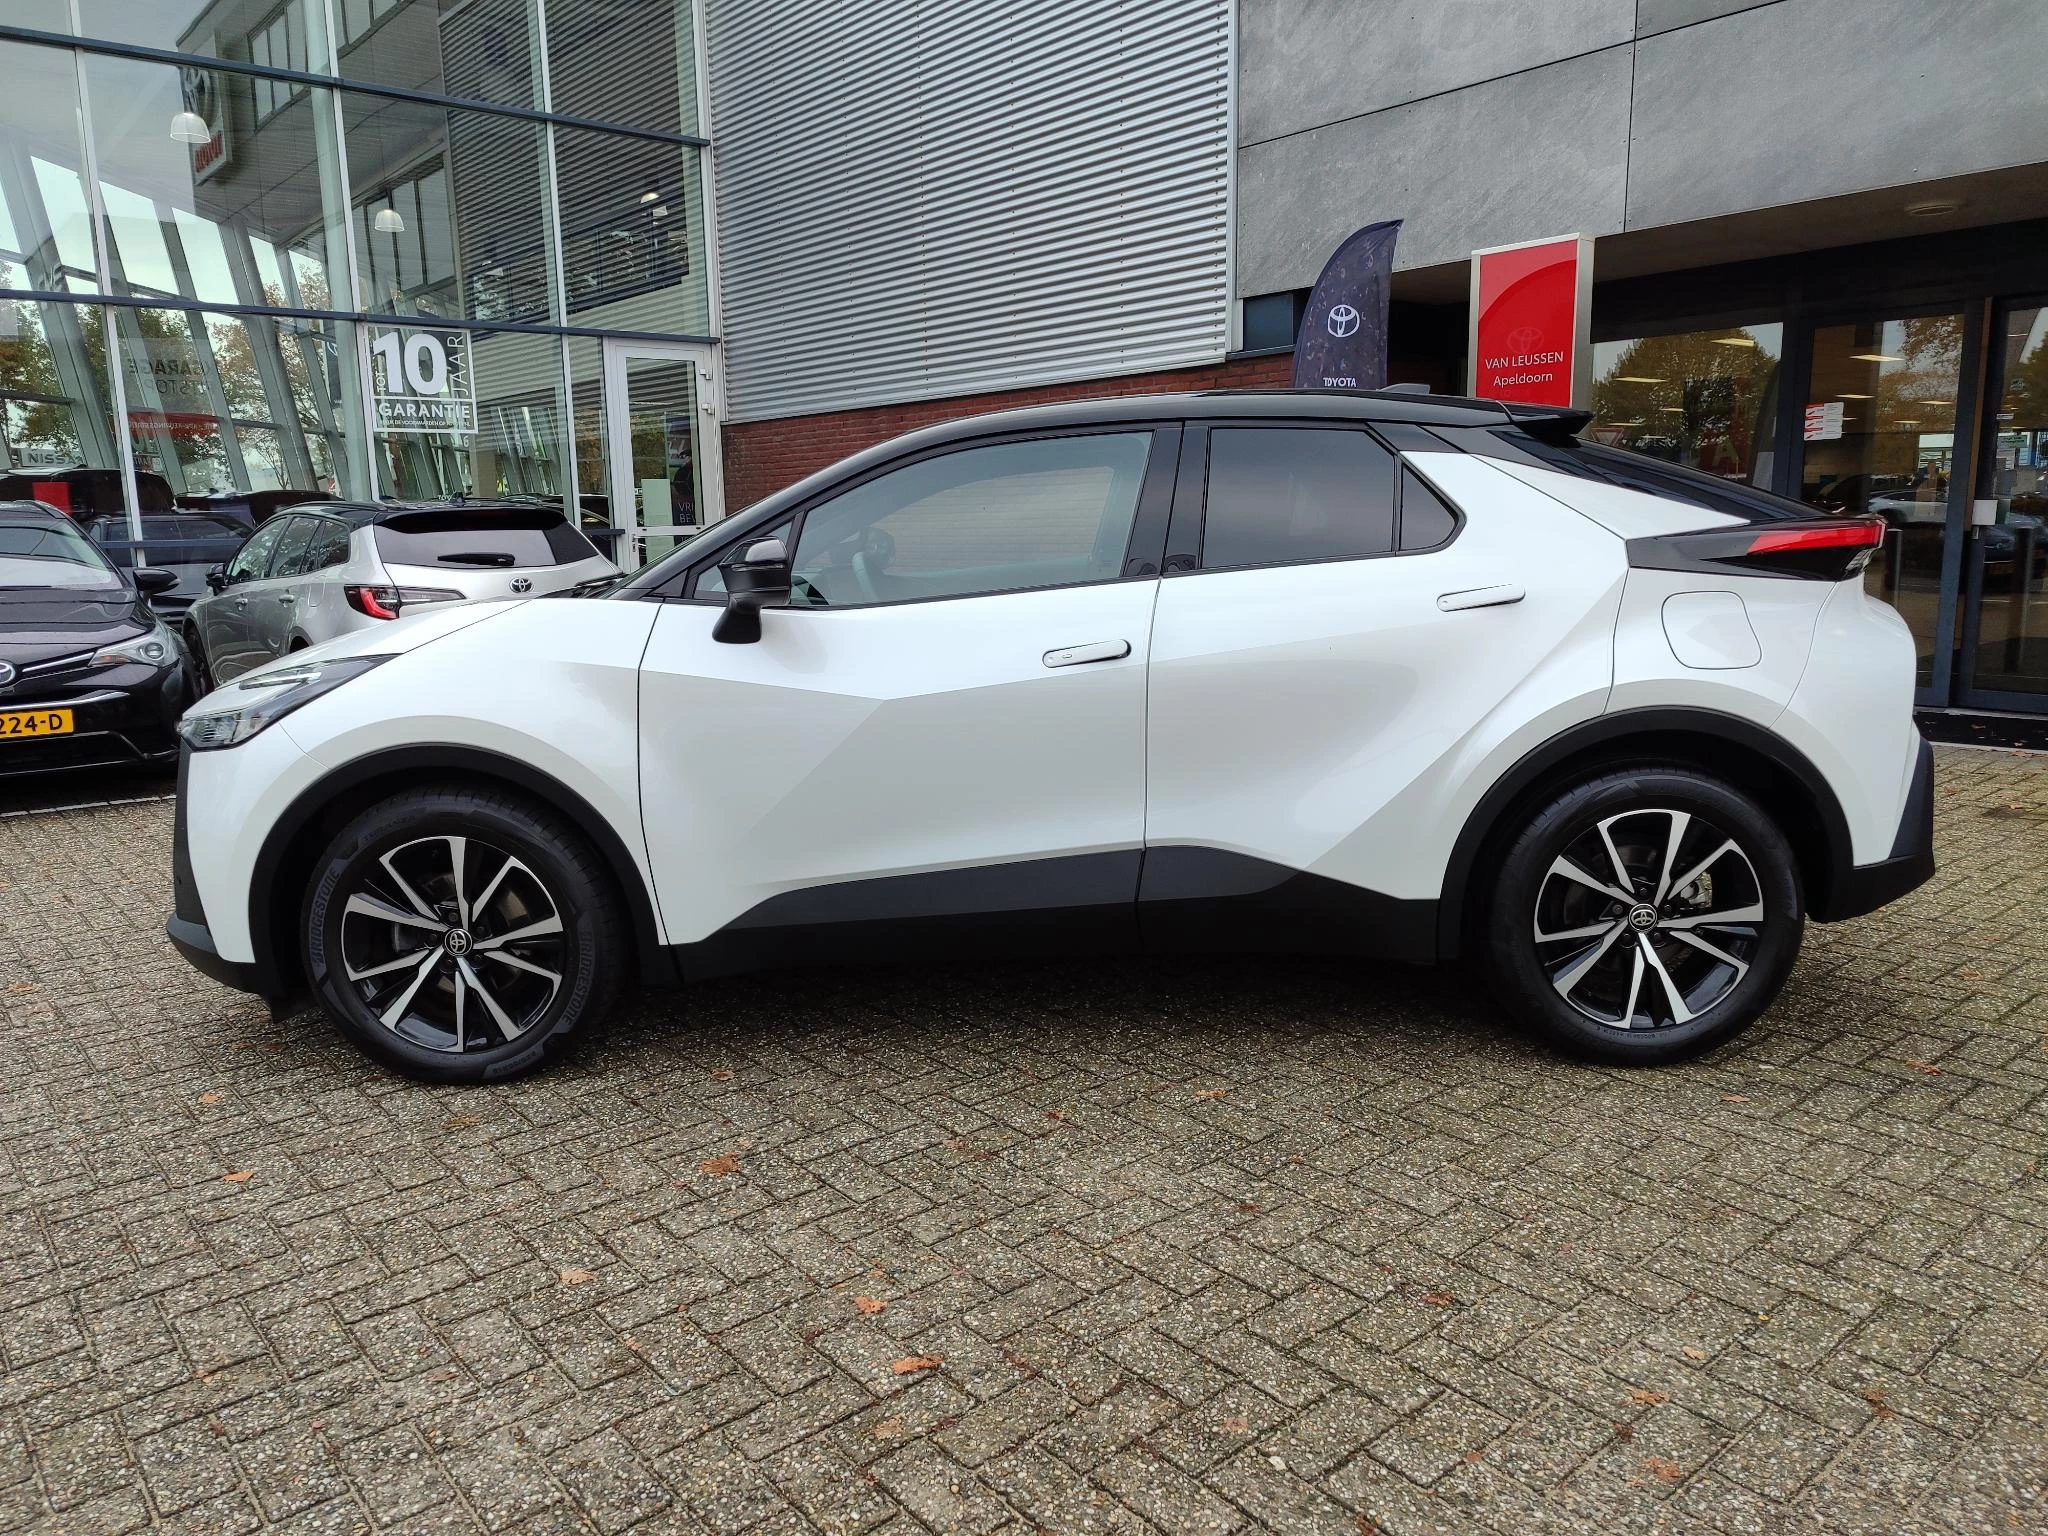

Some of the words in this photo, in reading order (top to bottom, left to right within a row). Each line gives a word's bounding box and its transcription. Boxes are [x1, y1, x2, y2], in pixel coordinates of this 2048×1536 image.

[372, 331, 448, 395] 10
[447, 335, 469, 396] JAAR
[1485, 357, 1509, 370] VAN
[1511, 351, 1564, 368] LEUSSEN
[375, 370, 387, 393] TOT
[1322, 377, 1357, 388] TOYOTA
[1493, 371, 1553, 389] Apeldoorn
[378, 402, 471, 419] GARANTIE
[0, 713, 63, 735] 224-D
[309, 868, 340, 968] BRIDGESTONE
[563, 930, 595, 1028] BRIDGESTONE
